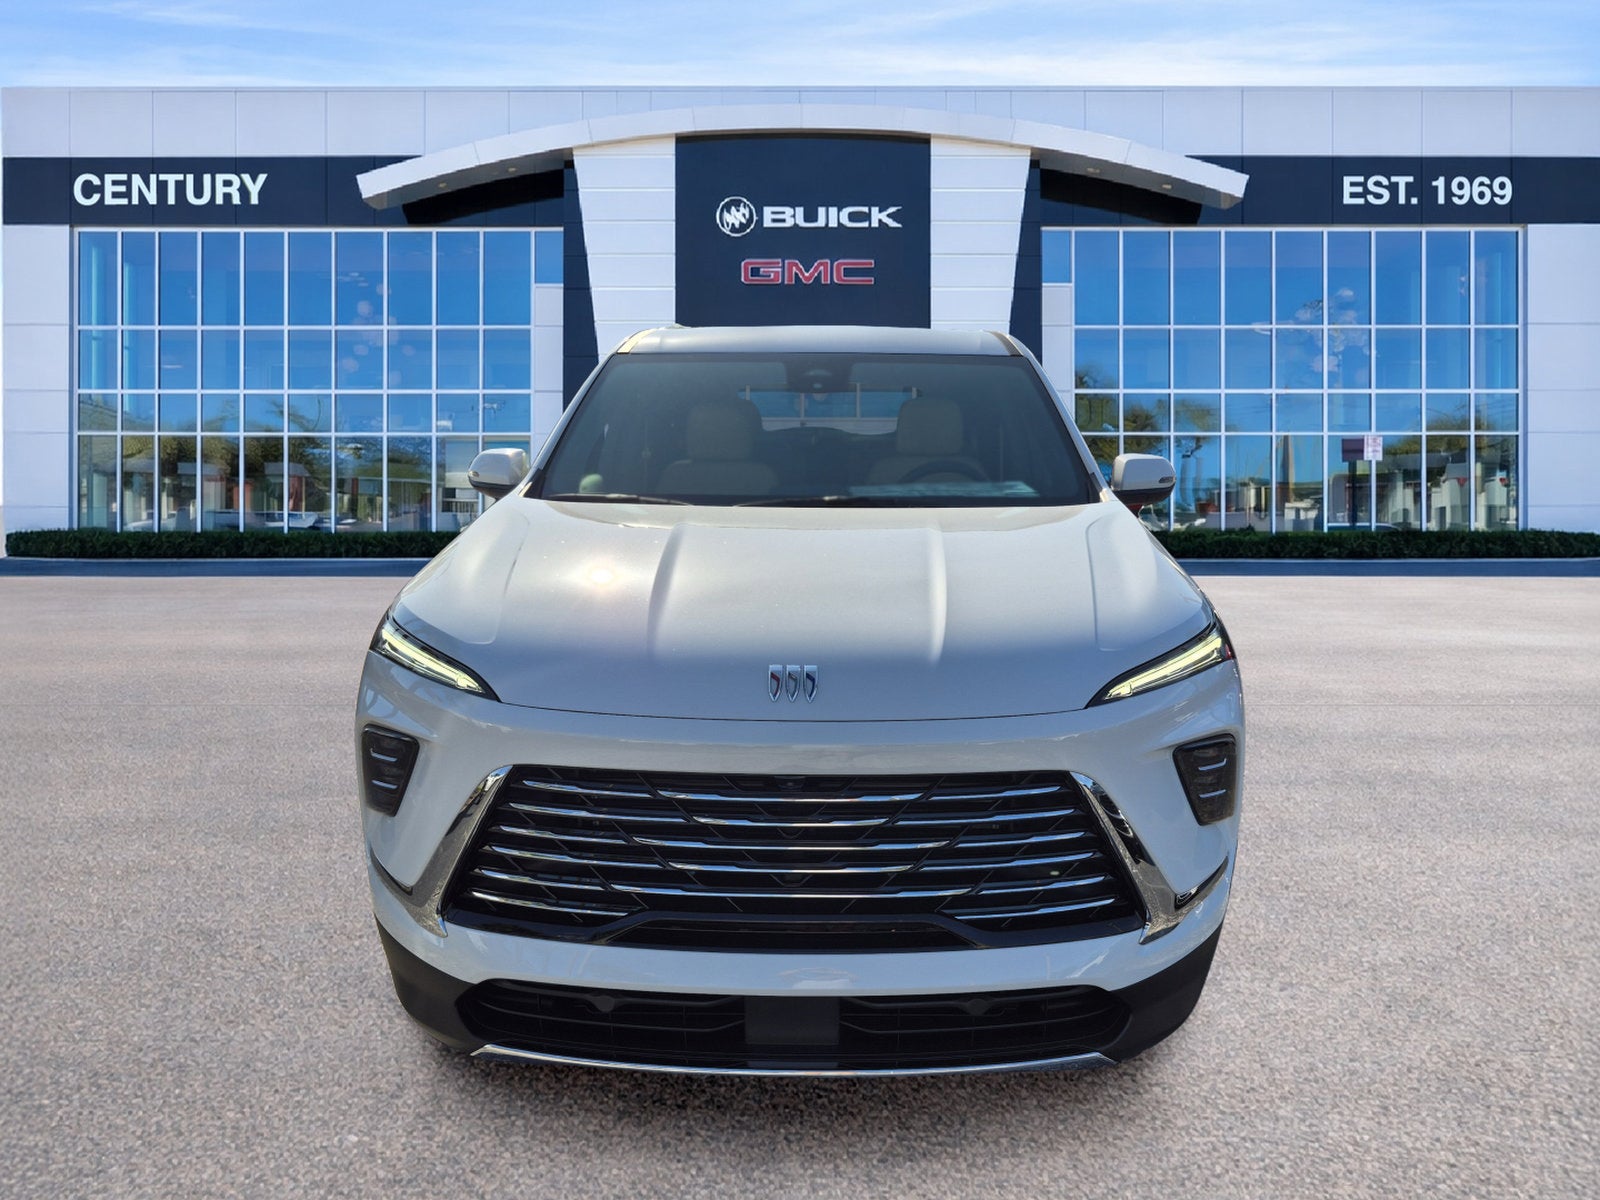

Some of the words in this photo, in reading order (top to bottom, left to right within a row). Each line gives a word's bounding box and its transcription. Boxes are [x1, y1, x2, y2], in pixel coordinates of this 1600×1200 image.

[73, 173, 268, 206] CENTURY
[1343, 175, 1418, 205] EST.
[1431, 175, 1513, 206] 1969
[762, 206, 903, 228] BUICK
[741, 258, 875, 285] GMC
